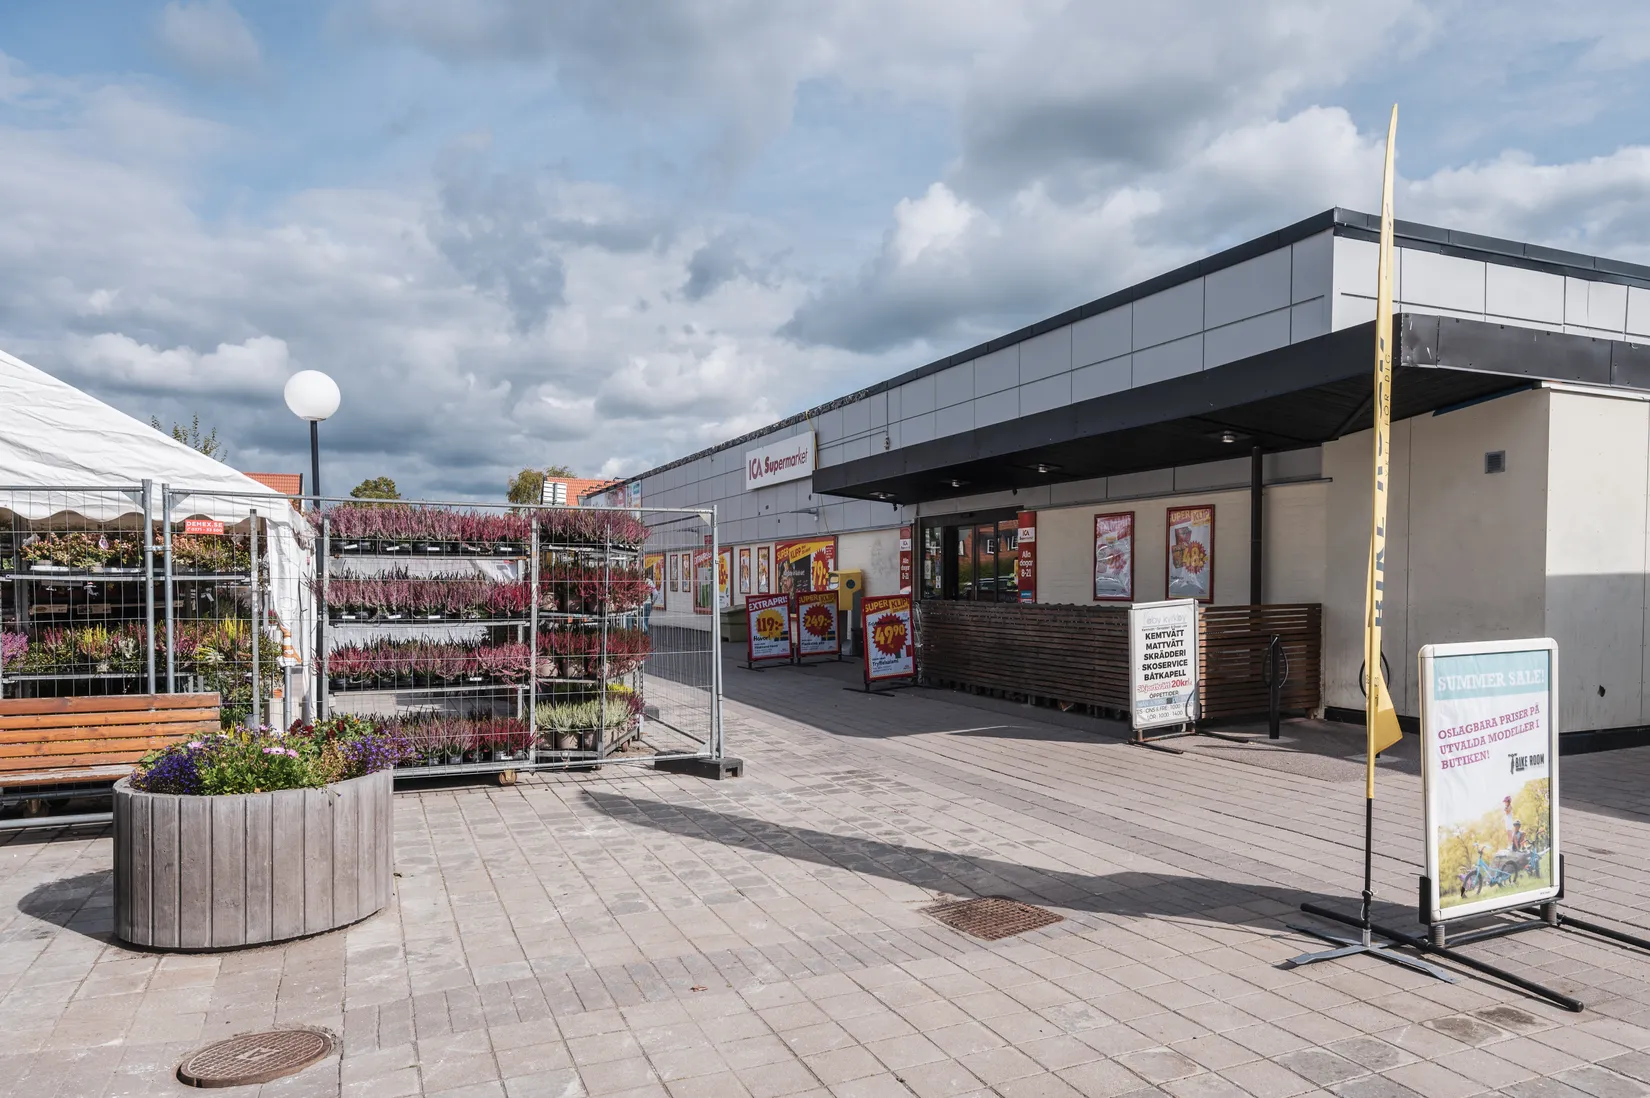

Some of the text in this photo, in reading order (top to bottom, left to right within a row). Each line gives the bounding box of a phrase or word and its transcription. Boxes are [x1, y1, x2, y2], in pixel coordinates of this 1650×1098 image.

[748, 446, 808, 480] ICA Supermarket
[1022, 550, 1031, 558] Alla
[1020, 559, 1033, 568] dagar
[865, 599, 889, 613] SUPER
[756, 617, 784, 633] 119:-
[805, 615, 832, 627] 249:-
[1145, 628, 1185, 641] KEMTVÄTT
[1145, 638, 1185, 651] MATTVÄTT
[1143, 649, 1187, 661] SKRÄDDERI
[1141, 659, 1188, 671] SKOSERVICE
[1144, 670, 1187, 681] BÅTKAPELL
[1438, 669, 1545, 691] SUMMER SALE!
[1438, 702, 1540, 740] OSLAGBARA PRISER PÅ
[1439, 719, 1540, 755] UTVALDA MODELLER I
[1441, 749, 1490, 770] BUTIKEN!
[1515, 755, 1528, 768] BIKE
[1529, 753, 1545, 766] ROOM
